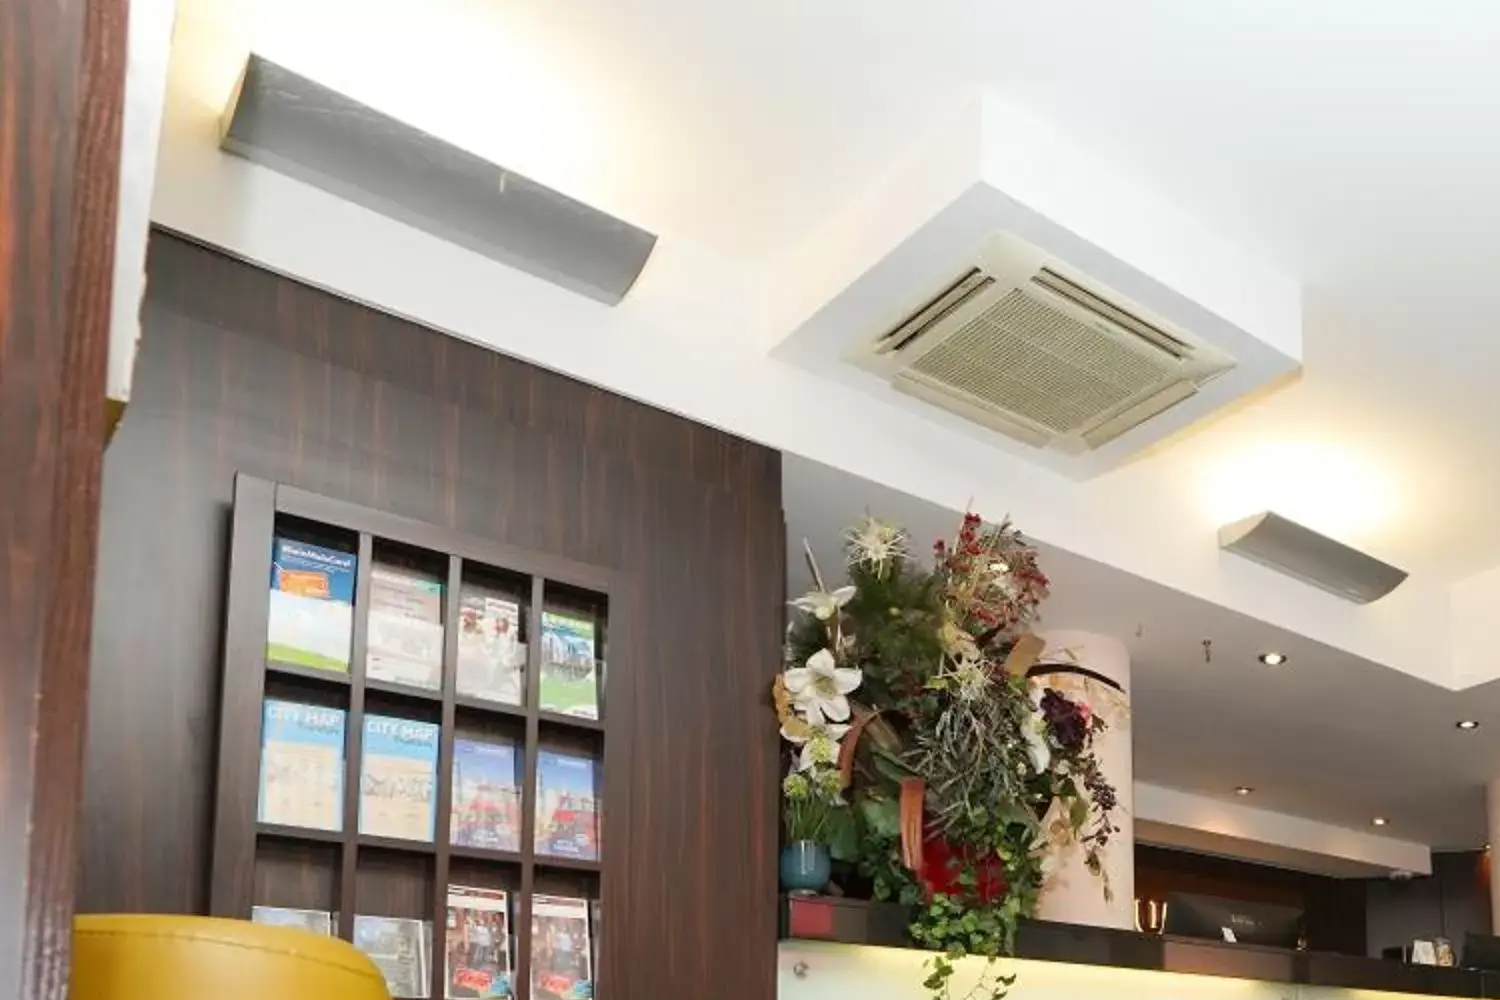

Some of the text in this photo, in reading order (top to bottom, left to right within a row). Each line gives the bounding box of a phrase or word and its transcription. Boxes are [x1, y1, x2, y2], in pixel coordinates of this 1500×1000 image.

[268, 706, 341, 726] CITY MAP
[366, 719, 435, 741] CITY MAP
